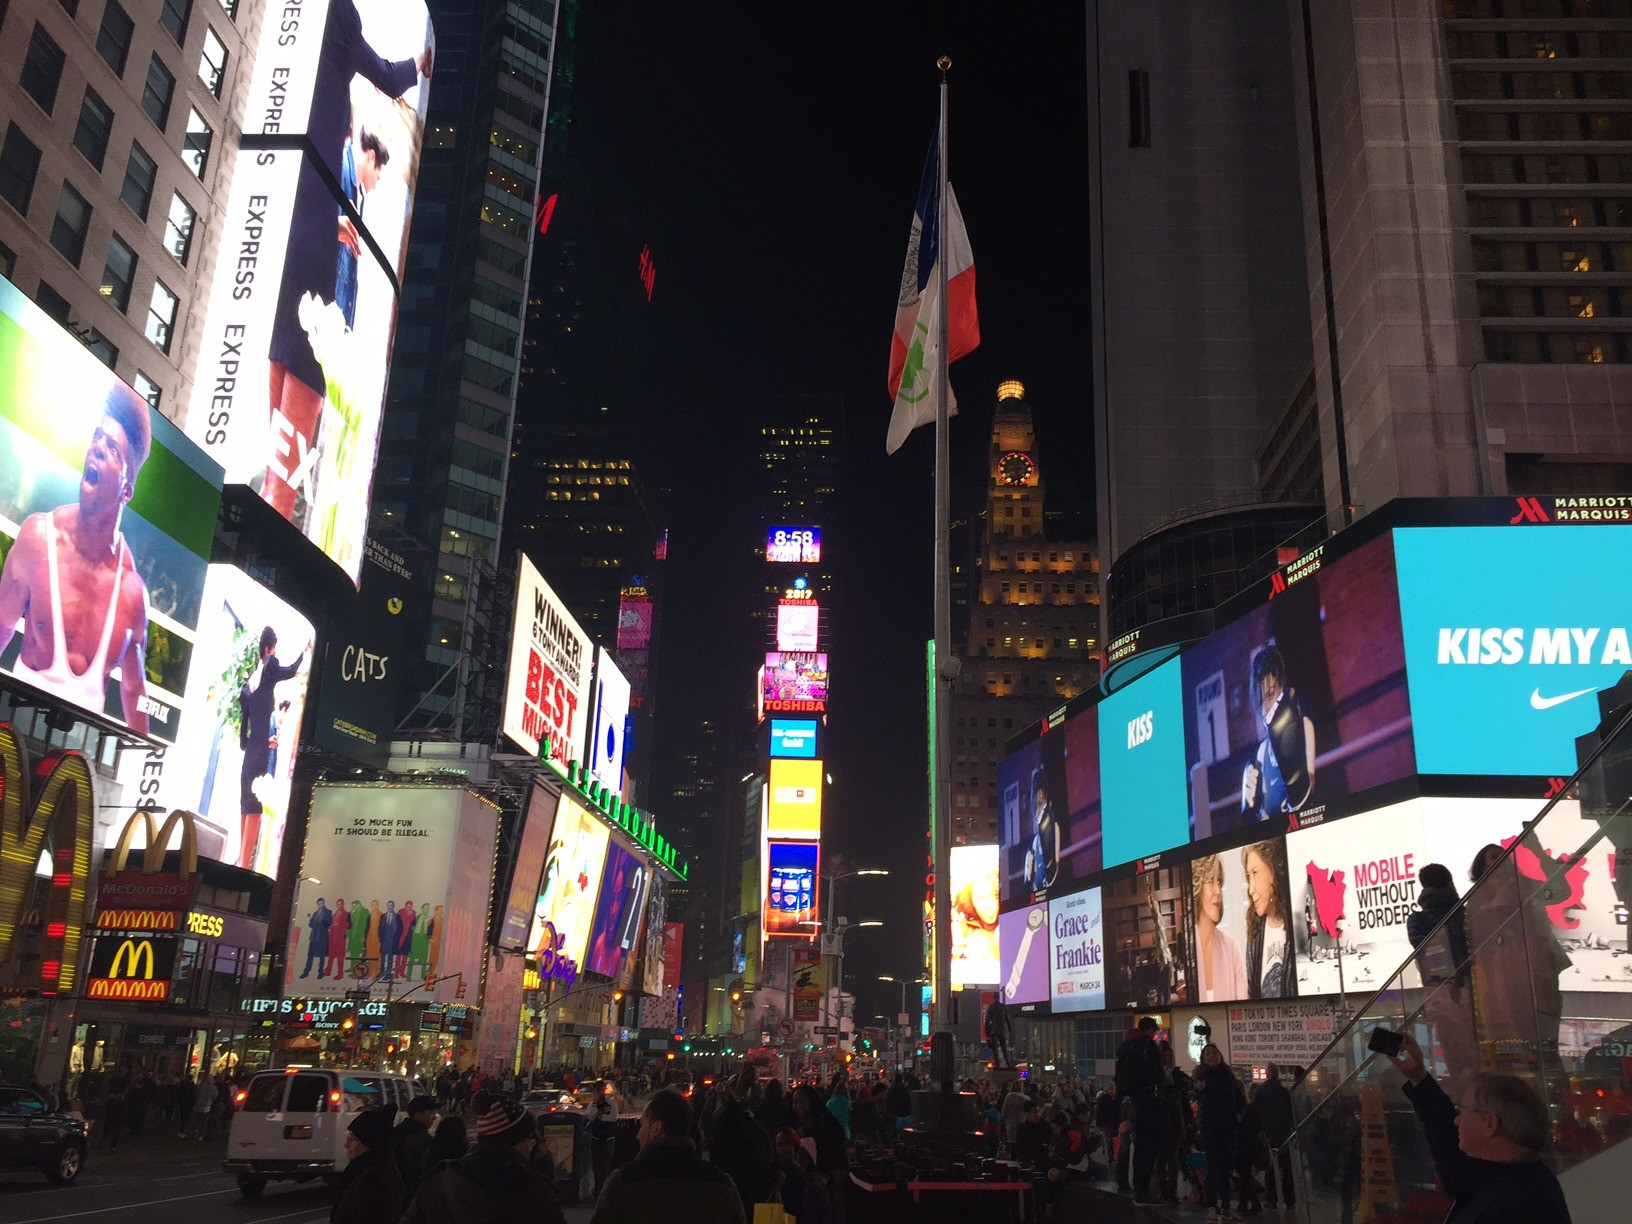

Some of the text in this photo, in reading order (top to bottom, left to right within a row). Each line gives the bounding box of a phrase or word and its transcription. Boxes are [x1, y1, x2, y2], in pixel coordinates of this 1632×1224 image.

[257, 67, 290, 166] EXPRES
[232, 194, 268, 301] EXPRESS
[205, 324, 246, 445] EXPRESS
[269, 407, 321, 507] EX
[1557, 509, 1630, 520] MARQUIS
[774, 530, 813, 546] 8:58
[372, 540, 389, 557] BACK
[390, 552, 405, 566] AND
[374, 551, 393, 569] THAN
[1286, 545, 1325, 575] MARRIOTT
[1287, 560, 1321, 586] MARQUIS
[785, 589, 813, 599] 2017
[535, 586, 583, 668] WINNER!
[533, 621, 538, 638] 6
[538, 626, 557, 658] TONY
[555, 649, 580, 688] AWARDS
[1108, 630, 1140, 653] MARRIOTT
[1109, 643, 1136, 664] MARQUIS
[1437, 627, 1524, 665] KISS
[1528, 627, 1600, 665] MY
[342, 645, 388, 682] CATS
[525, 646, 578, 740] BEST
[765, 700, 825, 711] TOSHIBA
[1127, 709, 1153, 750] KISS
[368, 819, 394, 827] MUCH
[396, 819, 413, 827] FUN
[1300, 805, 1325, 818] MARRIOTT
[346, 828, 379, 836] SHOULD
[611, 795, 677, 867] BROADWAY
[1354, 853, 1416, 889] MOBILE
[102, 882, 188, 896] McDonald's
[1357, 880, 1417, 910] WITHOUT
[1055, 912, 1088, 940] Grace
[1056, 938, 1101, 970] Frankie
[1057, 981, 1075, 995] NETFLIX
[1080, 982, 1094, 991] MARCH
[241, 999, 388, 1016] GIFTS LUGE
[1244, 1008, 1265, 1020] TOKYO
[1267, 1007, 1275, 1018] TO
[1277, 1005, 1298, 1018] TIMES
[1301, 1004, 1330, 1019] SQUARE
[1231, 1019, 1331, 1032] PARIS LONDON NEW YORK UNIQLO
[1258, 1034, 1280, 1042] TORONTO
[1281, 1033, 1304, 1042] SHANGHAI
[1308, 1033, 1332, 1042] CHICAGO
